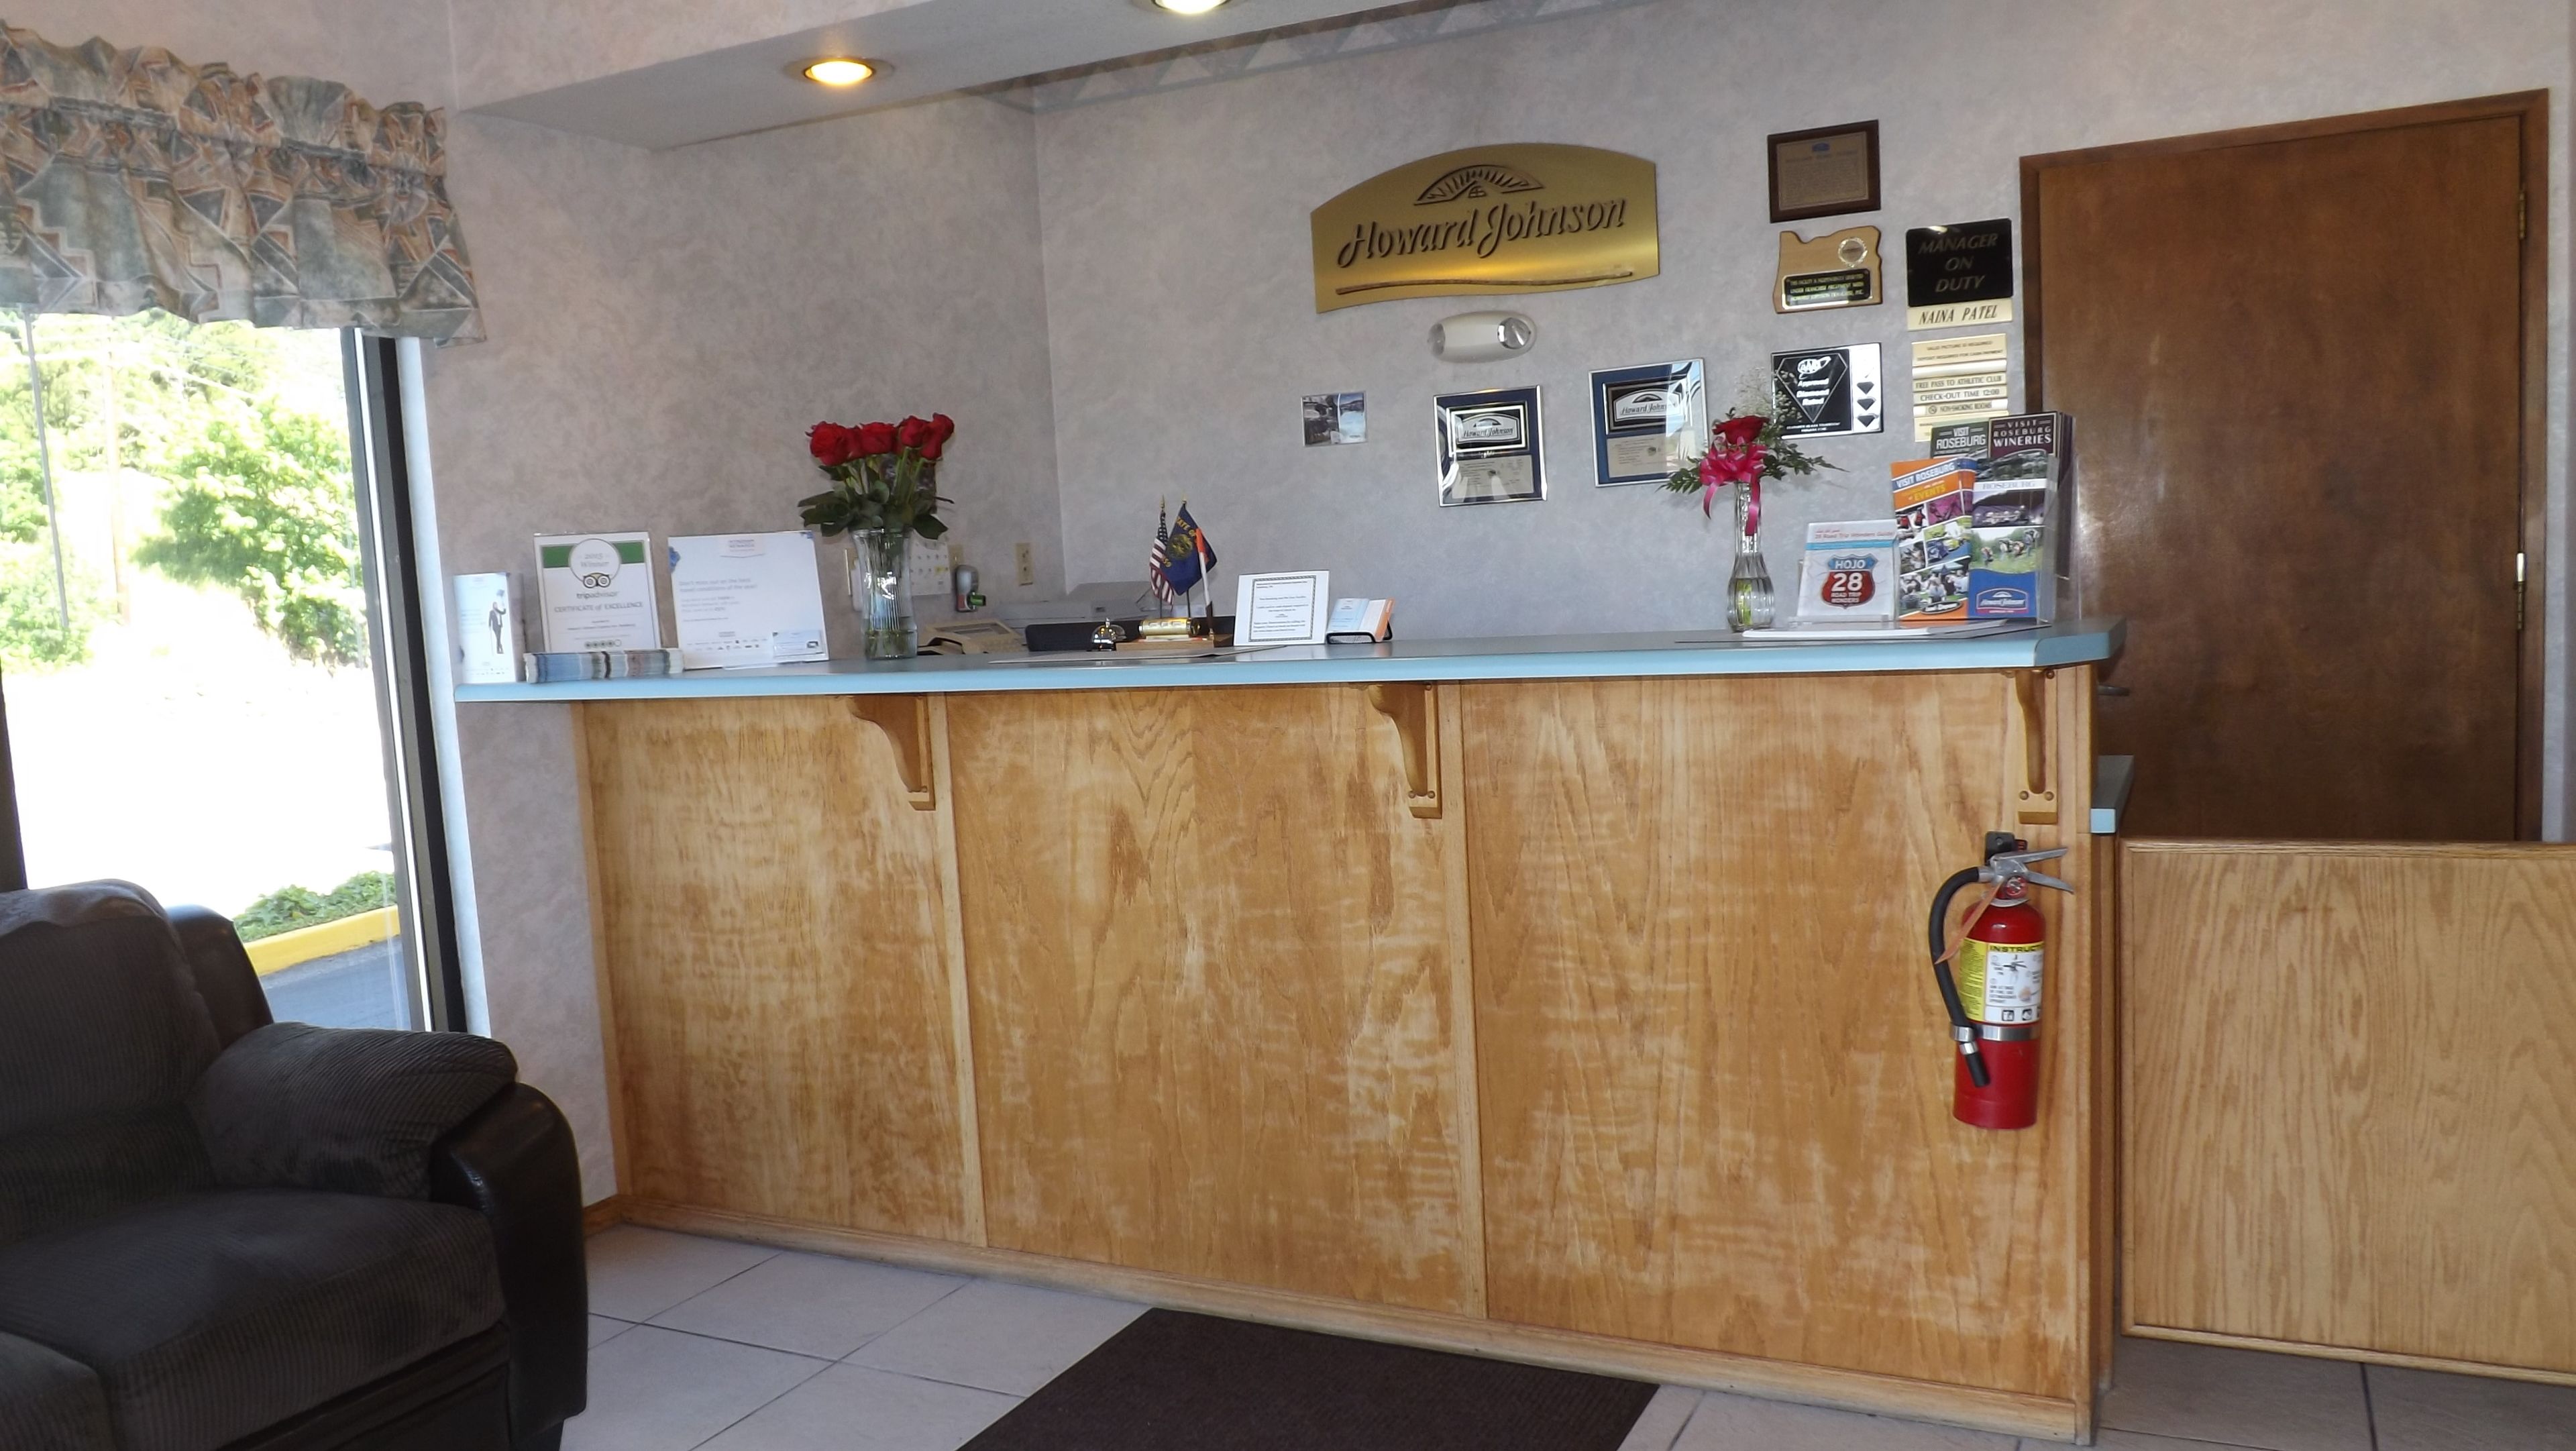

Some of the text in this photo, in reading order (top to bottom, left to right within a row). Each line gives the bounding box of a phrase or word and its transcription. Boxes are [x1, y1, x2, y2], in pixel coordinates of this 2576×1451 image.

[1337, 199, 1626, 268] Howard Johnson
[1918, 233, 1998, 255] MANAGER
[1945, 256, 1974, 271] ON
[1935, 274, 1986, 293] DUTY
[1919, 305, 1998, 325] NAINA PATEL
[1921, 391, 1961, 401] CHECK-OUT
[1620, 404, 1648, 415] Howard
[2007, 419, 2037, 428] VISIT
[1463, 427, 1514, 438] Howard Johnson
[1953, 426, 1970, 437] VISIT
[1993, 426, 2051, 437] ROSEBURG
[1936, 434, 1986, 450] ROSEBURG
[1993, 434, 2052, 447] WINERIES
[1896, 476, 1915, 488] VISIT
[1915, 464, 1955, 482] ROSEBURG
[1982, 481, 2035, 490] ROSEBURG
[1914, 484, 1946, 501] EVENTS
[1835, 559, 1866, 569] HOJO
[1831, 572, 1863, 592] 28
[554, 604, 593, 613] CERTIFICATE
[604, 601, 643, 610] EXCELLENCE
